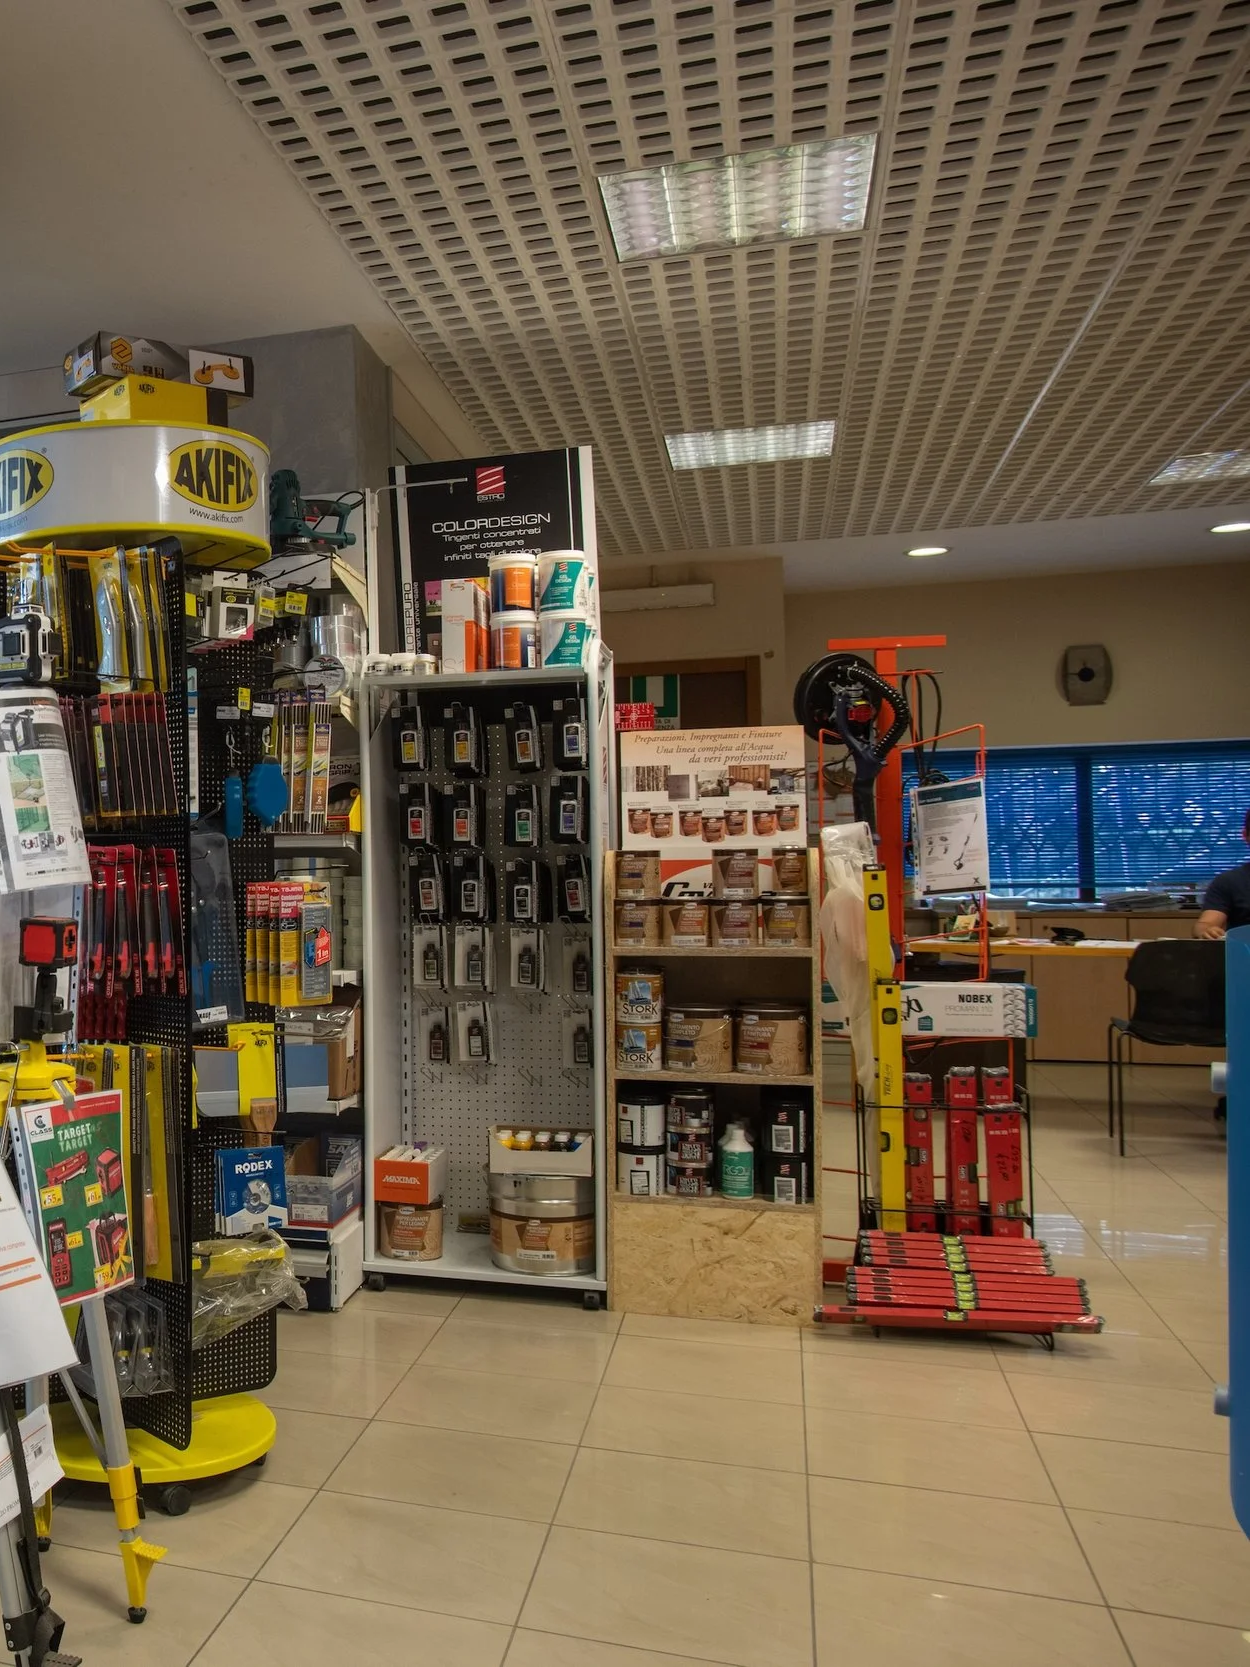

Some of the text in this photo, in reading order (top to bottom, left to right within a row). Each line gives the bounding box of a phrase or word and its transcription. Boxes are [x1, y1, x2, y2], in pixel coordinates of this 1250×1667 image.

[174, 447, 254, 505] AKIFIX
[189, 506, 244, 524] www.akifix.com
[432, 512, 550, 534] COLORDESIGN
[442, 527, 542, 543] Tingenti concentrati
[460, 539, 524, 552] per ottenere
[444, 553, 472, 562] infiniti
[690, 732, 741, 742] Impregnanti
[749, 730, 783, 739] Finiture
[656, 745, 674, 754] Una
[676, 745, 696, 754] linea
[697, 745, 733, 754] completa
[688, 751, 788, 766] da veri professionisti!
[958, 994, 992, 1003] NOBEX
[622, 1003, 658, 1015] STORK
[619, 1052, 653, 1064] STORK
[30, 1127, 53, 1137] CLASS
[57, 1122, 91, 1143] TARGET
[59, 1134, 92, 1153] TARGET
[235, 1159, 273, 1174] RODEX
[382, 1174, 421, 1185] MAXIMA
